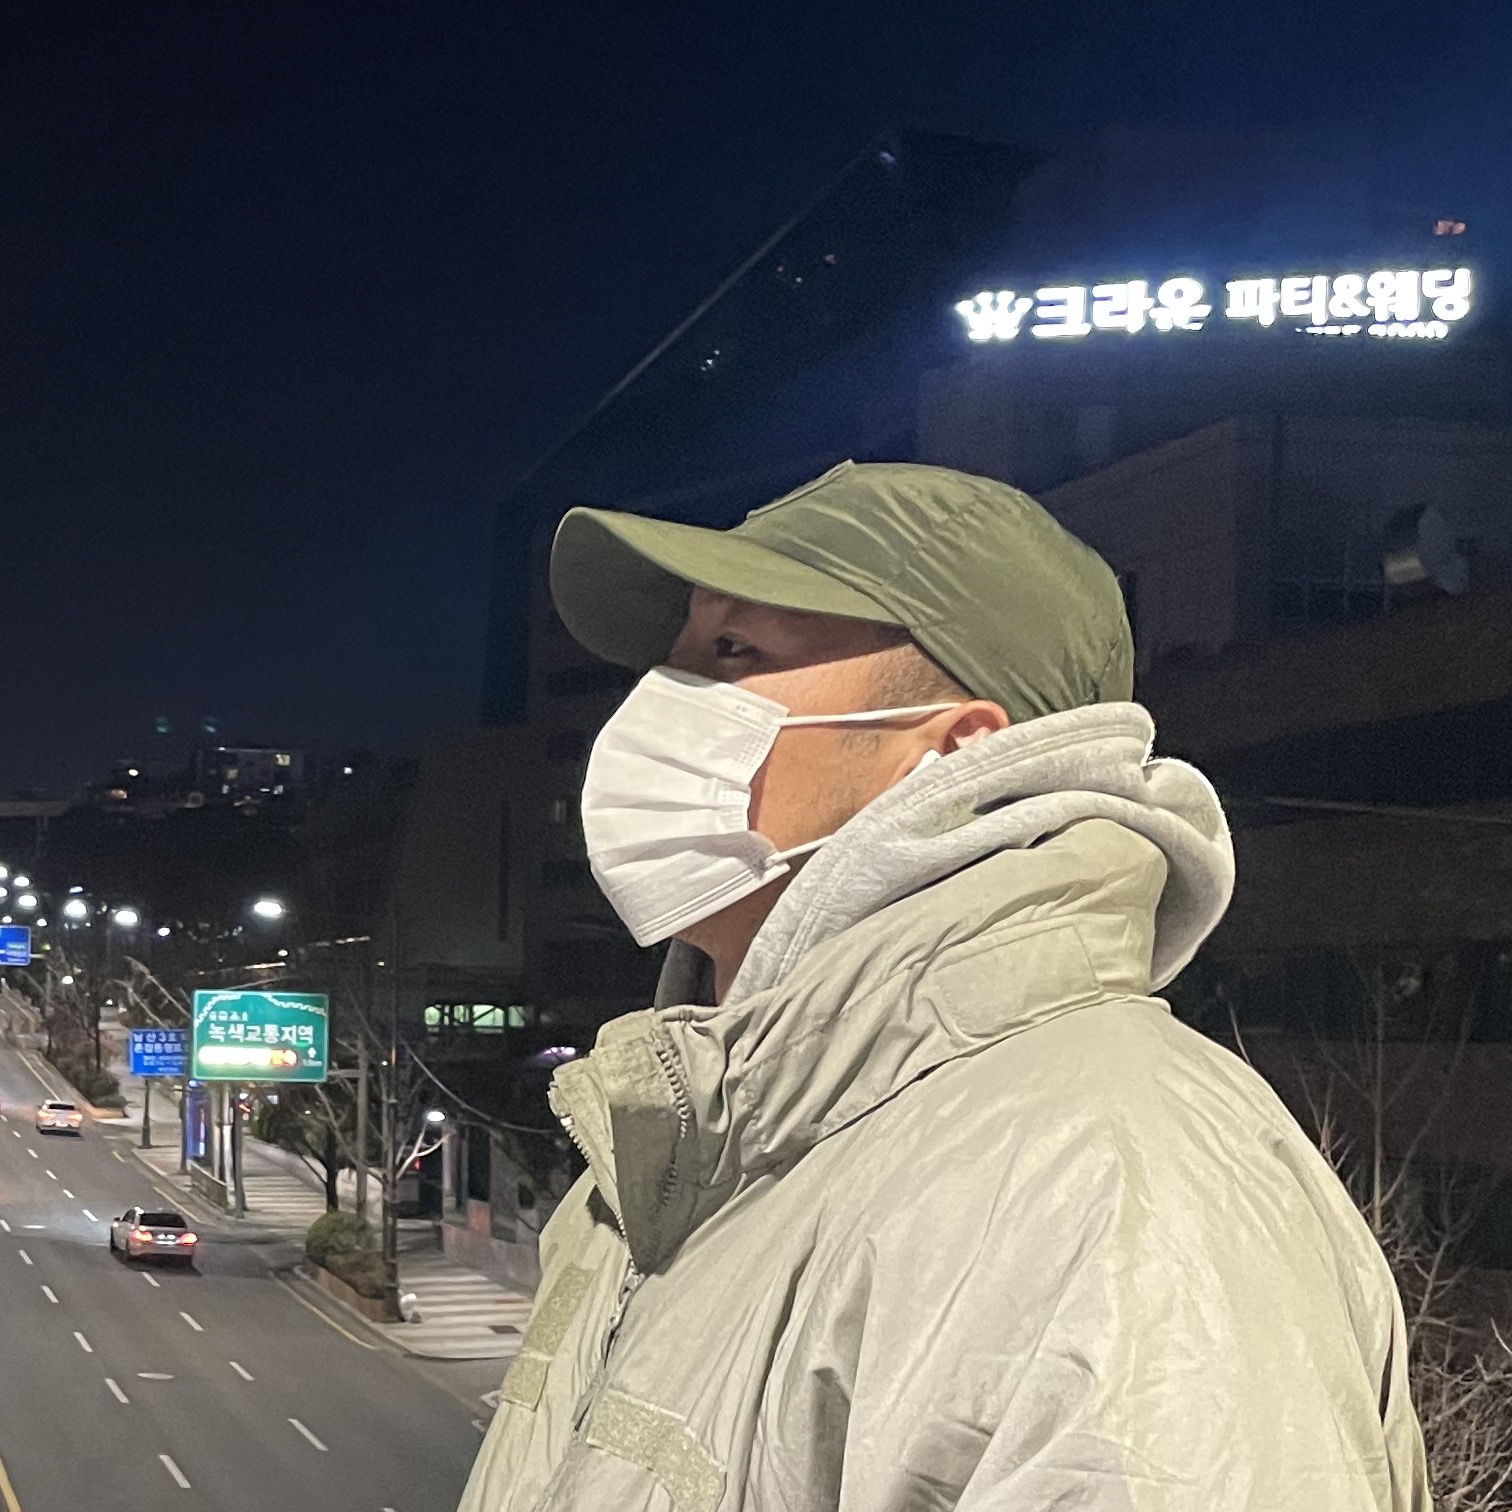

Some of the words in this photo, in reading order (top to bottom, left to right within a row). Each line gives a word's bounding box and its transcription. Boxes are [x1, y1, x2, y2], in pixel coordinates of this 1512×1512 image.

[1031, 277, 1212, 339] 크라운
[1225, 267, 1472, 326] 파티&웨딩
[208, 1022, 314, 1045] 녹색교통지역
